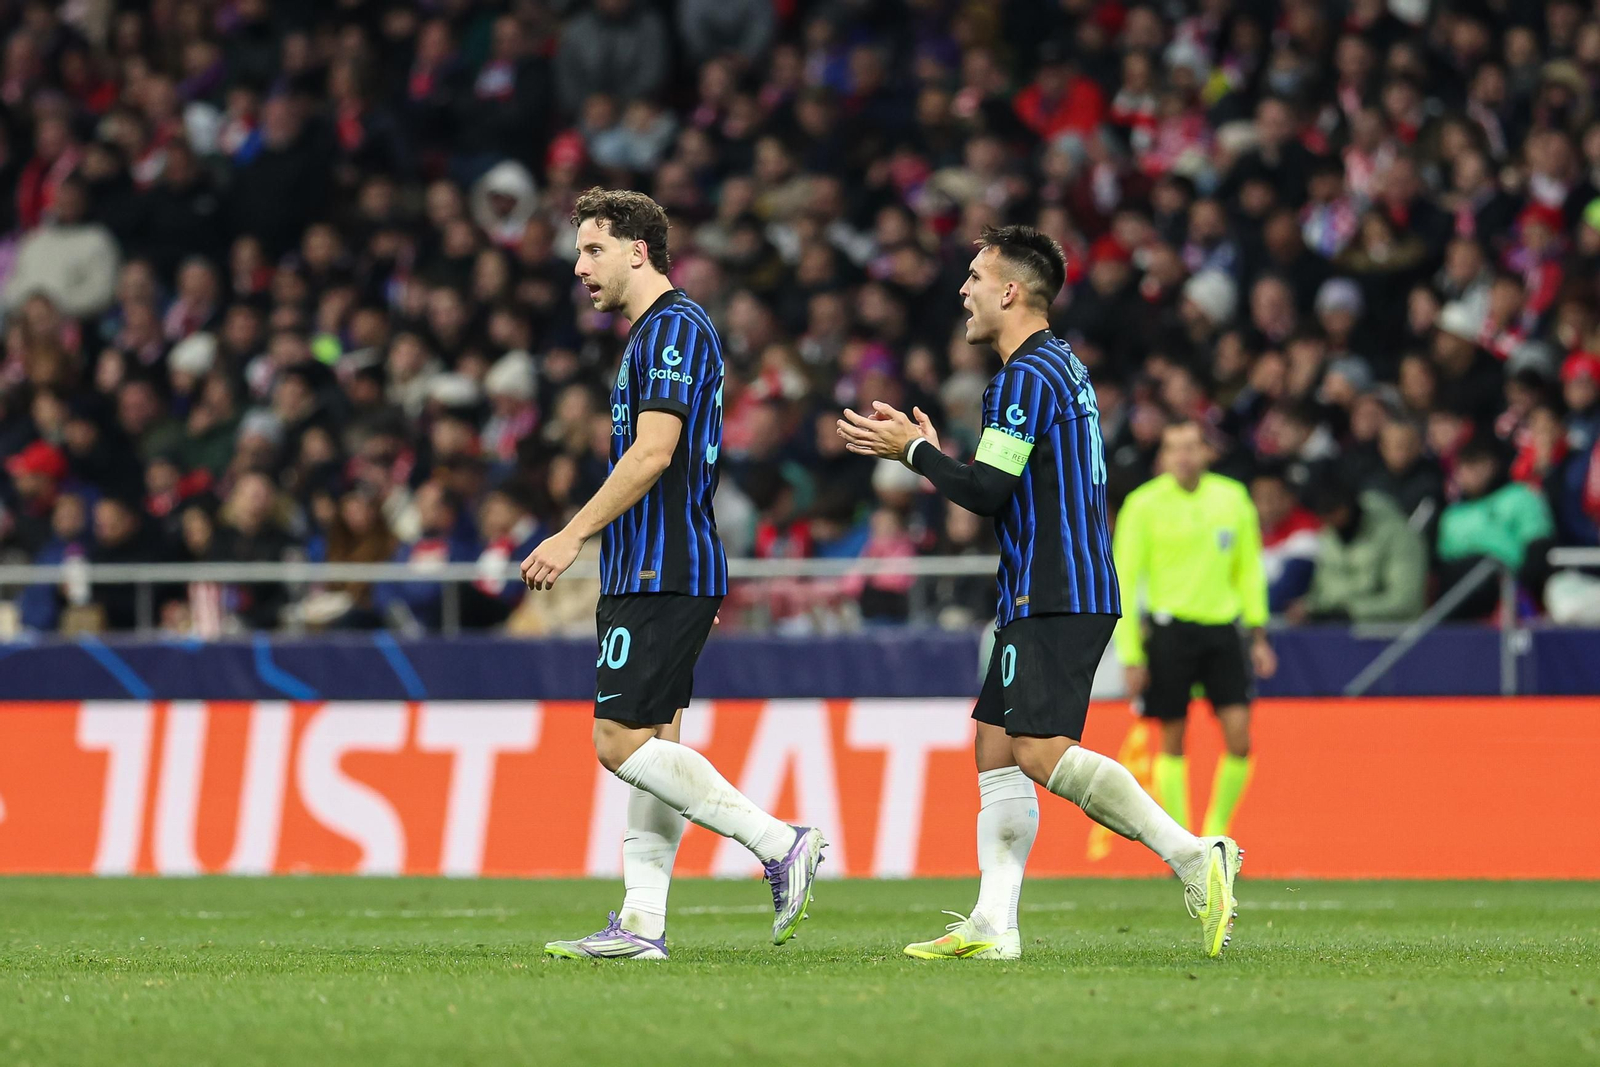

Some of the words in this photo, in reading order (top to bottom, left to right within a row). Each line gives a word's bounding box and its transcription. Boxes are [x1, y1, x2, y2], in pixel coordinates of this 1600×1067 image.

[649, 368, 693, 385] Gate.io
[1001, 644, 1016, 687] 0
[76, 700, 541, 876] JUST
